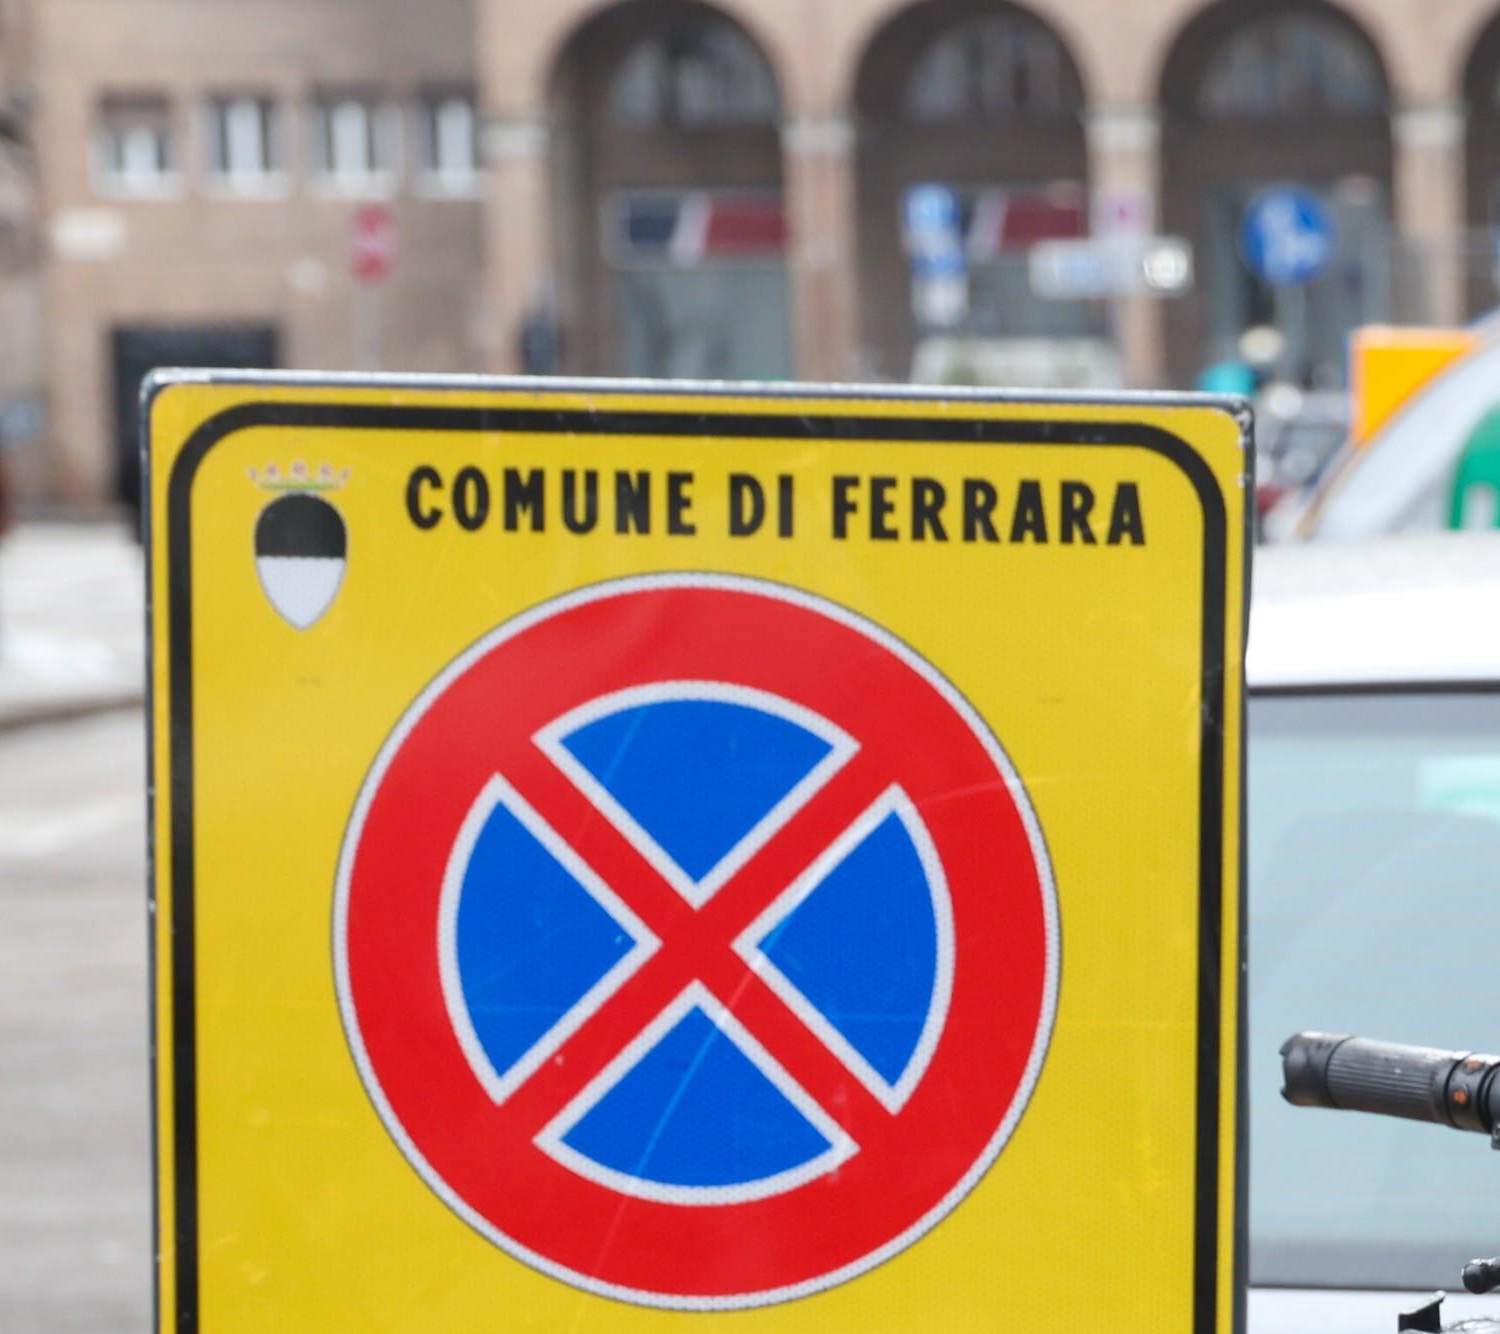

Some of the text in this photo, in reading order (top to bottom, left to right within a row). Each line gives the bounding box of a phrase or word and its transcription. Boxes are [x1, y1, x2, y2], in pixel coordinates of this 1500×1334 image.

[405, 465, 1146, 546] COMUNE DI FERRARA
